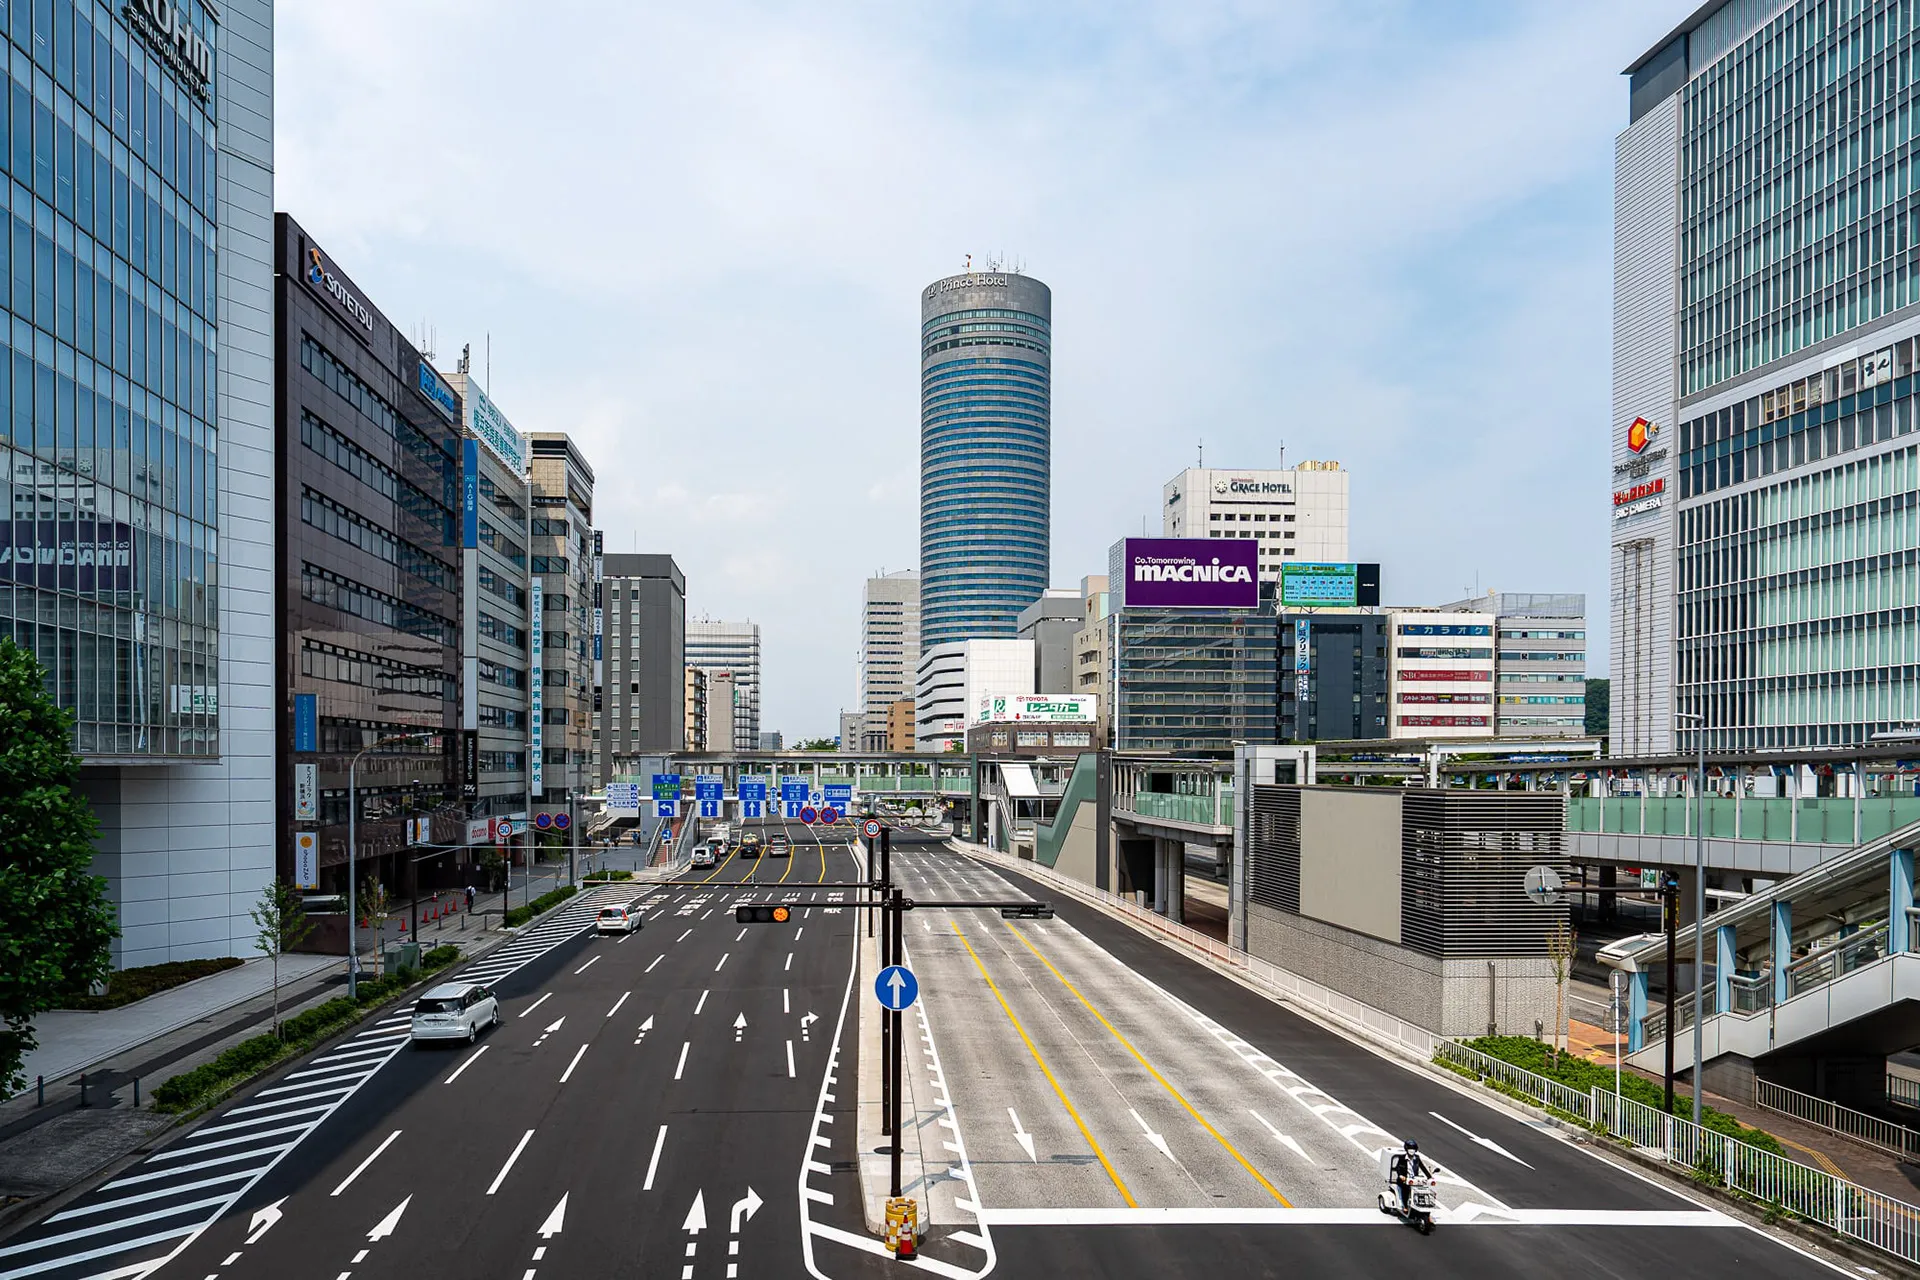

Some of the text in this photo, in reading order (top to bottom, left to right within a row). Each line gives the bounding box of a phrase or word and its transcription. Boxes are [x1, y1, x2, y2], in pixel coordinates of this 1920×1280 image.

[130, 6, 211, 104] SEMICONDUCTOR
[940, 273, 1008, 294] Prince Hotel
[325, 271, 373, 331] SOTETSU
[1230, 481, 1292, 494] GRACE HOTEL
[1629, 497, 1662, 517] CAMERA
[1134, 556, 1196, 566] Co.Tomorrowing
[1424, 626, 1484, 635] カラオケ
[1403, 671, 1420, 680] SBC
[1029, 703, 1078, 712] レンタカー
[471, 827, 487, 839] docomo
[500, 825, 510, 834] 50
[867, 824, 878, 833] 50
